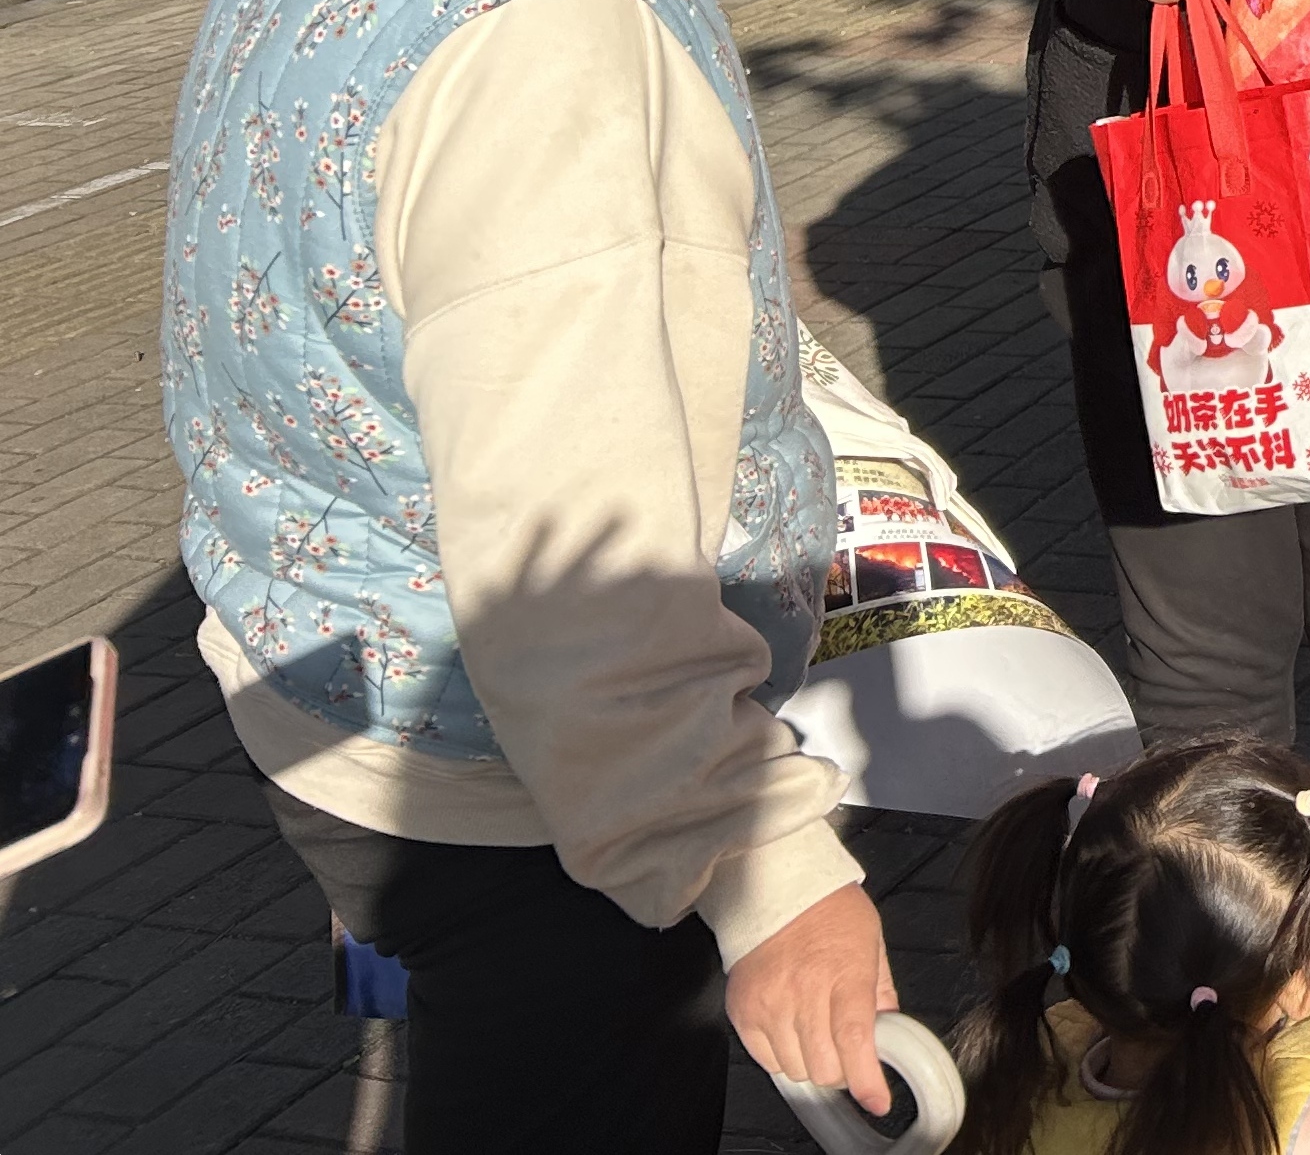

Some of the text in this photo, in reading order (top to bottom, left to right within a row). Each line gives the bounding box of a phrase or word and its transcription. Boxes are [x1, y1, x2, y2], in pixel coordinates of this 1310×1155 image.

[1162, 381, 1290, 434] 奶茶在手
[1170, 428, 1297, 477] 天冷不抖
